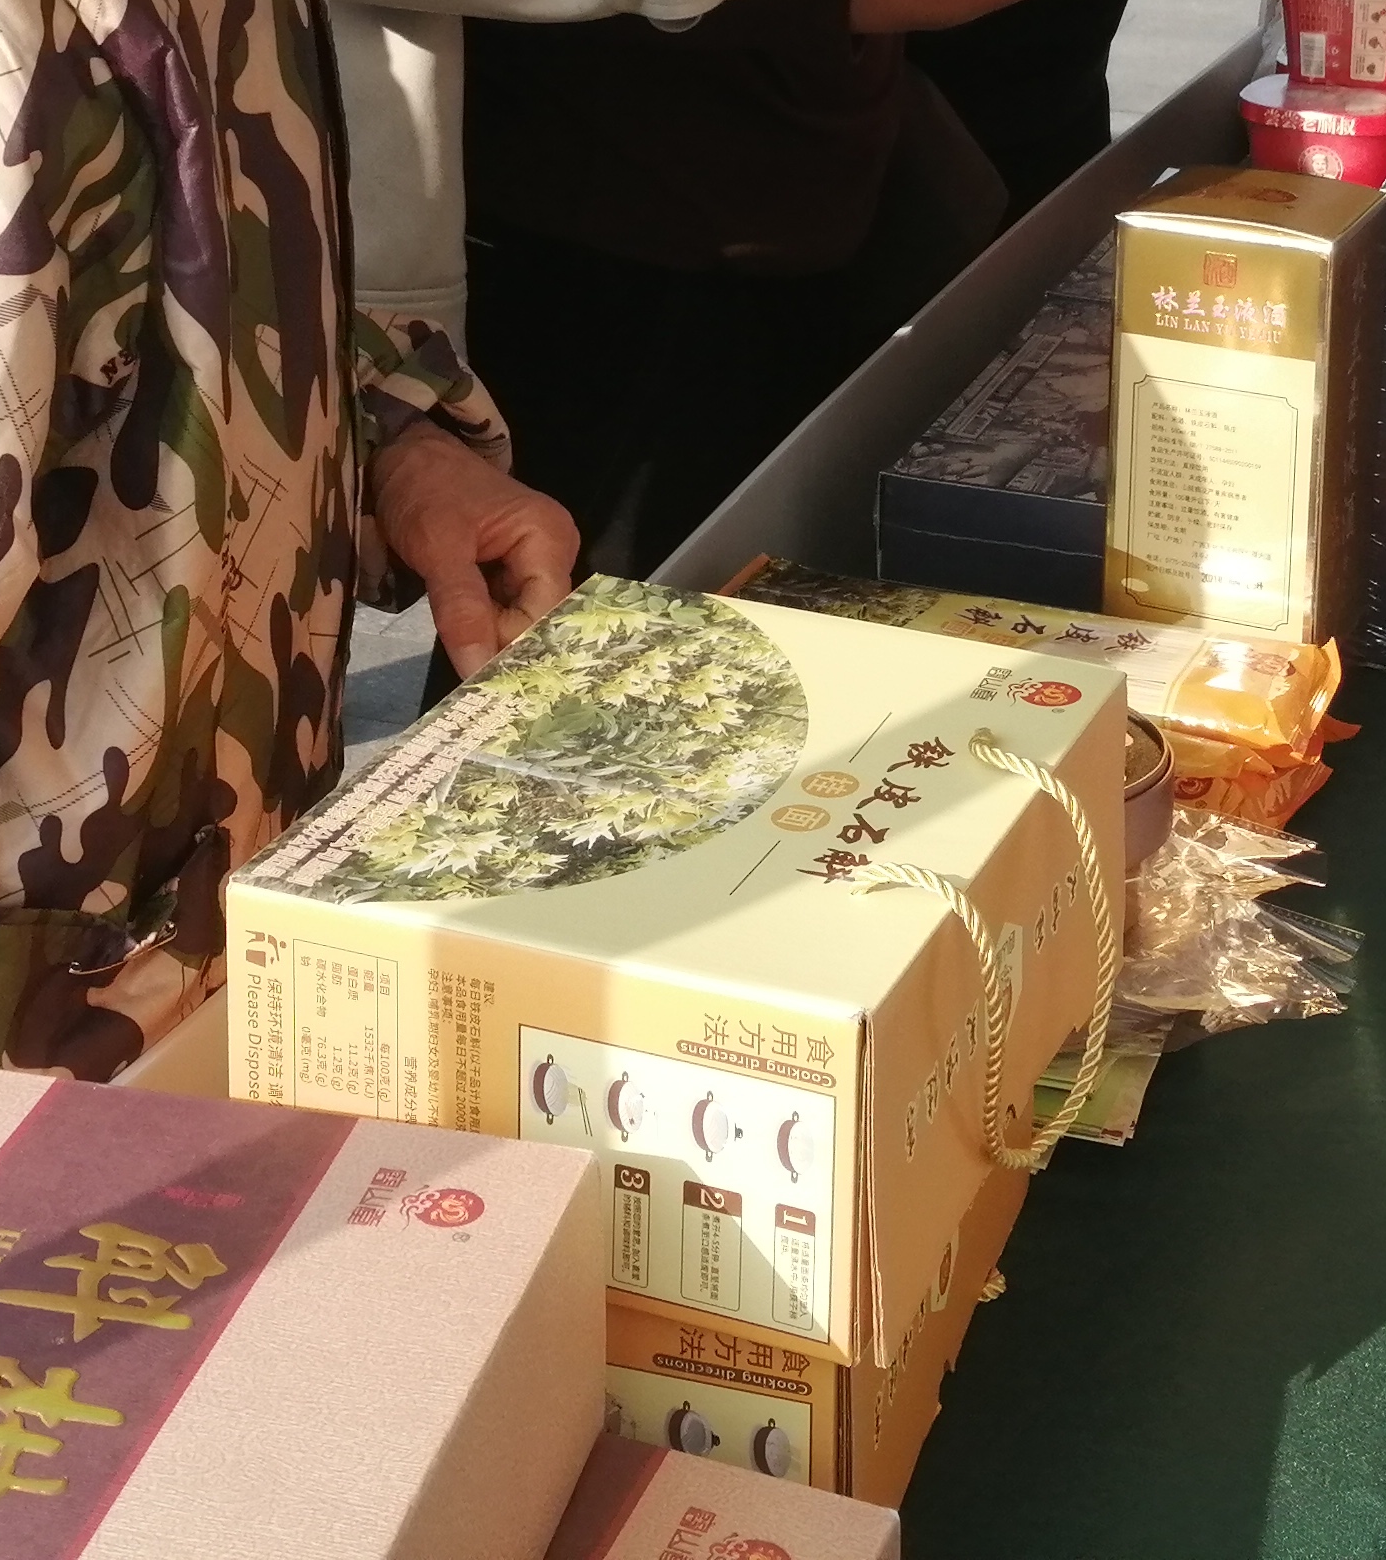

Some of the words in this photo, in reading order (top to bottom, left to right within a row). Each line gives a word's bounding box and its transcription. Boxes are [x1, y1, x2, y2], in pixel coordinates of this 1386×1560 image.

[1155, 313, 1179, 329] LIN
[1183, 318, 1211, 333] LAN
[347, 965, 359, 1001] 蛋白质
[363, 970, 375, 992] 能量
[379, 972, 391, 996] 项目
[246, 973, 262, 1029] Please
[267, 978, 283, 1078] 保持环境清洁
[704, 1012, 834, 1070] 食用方法
[245, 1033, 263, 1100] Dispose
[679, 1041, 761, 1071] directions
[766, 1059, 833, 1088] Cooking
[620, 1169, 644, 1190] 3
[700, 1189, 725, 1209] 2
[783, 1210, 808, 1225] 1
[679, 1327, 811, 1379] 食用方法
[656, 1355, 736, 1383] directions
[742, 1370, 809, 1396] Cooking
